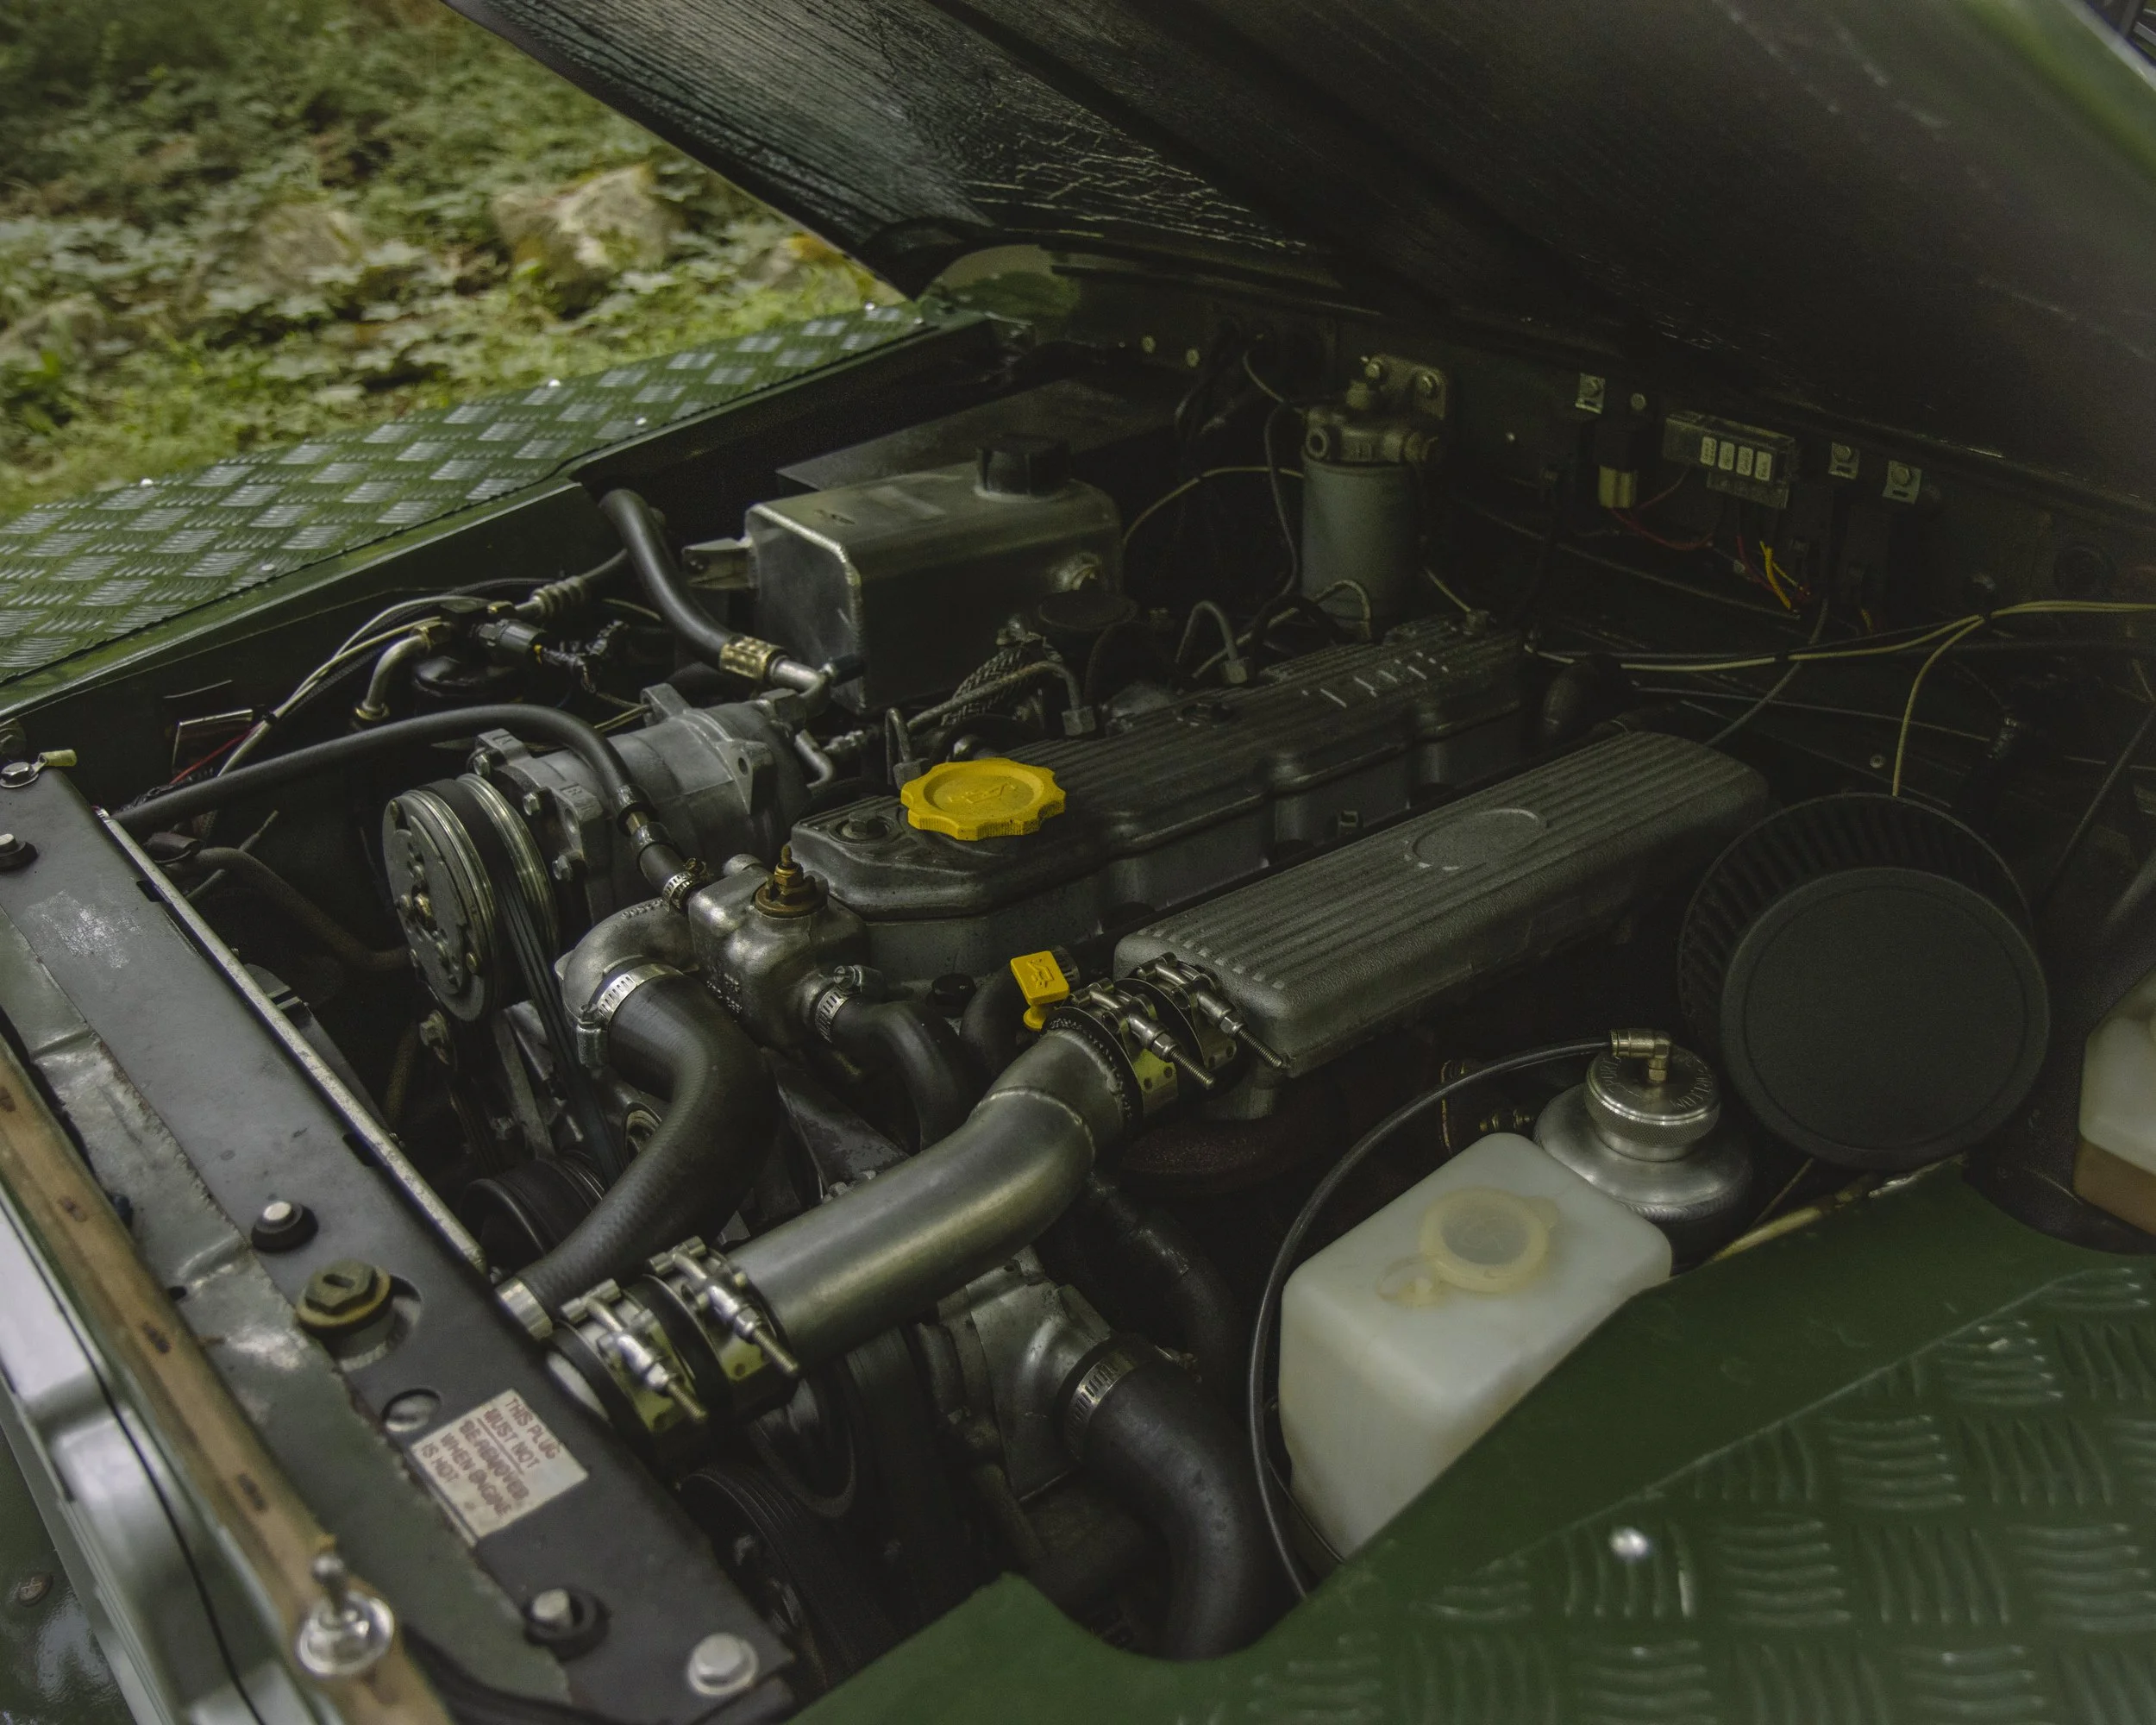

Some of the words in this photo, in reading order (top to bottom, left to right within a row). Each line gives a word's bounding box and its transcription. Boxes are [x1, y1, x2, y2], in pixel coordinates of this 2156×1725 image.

[441, 1433, 475, 1471] WHEN
[484, 1408, 518, 1442] MUST
[511, 1440, 540, 1469] NOT
[505, 1398, 533, 1427] THIS
[527, 1425, 561, 1460] PLUG
[421, 1443, 439, 1458] IS
[430, 1457, 461, 1483] NOT
